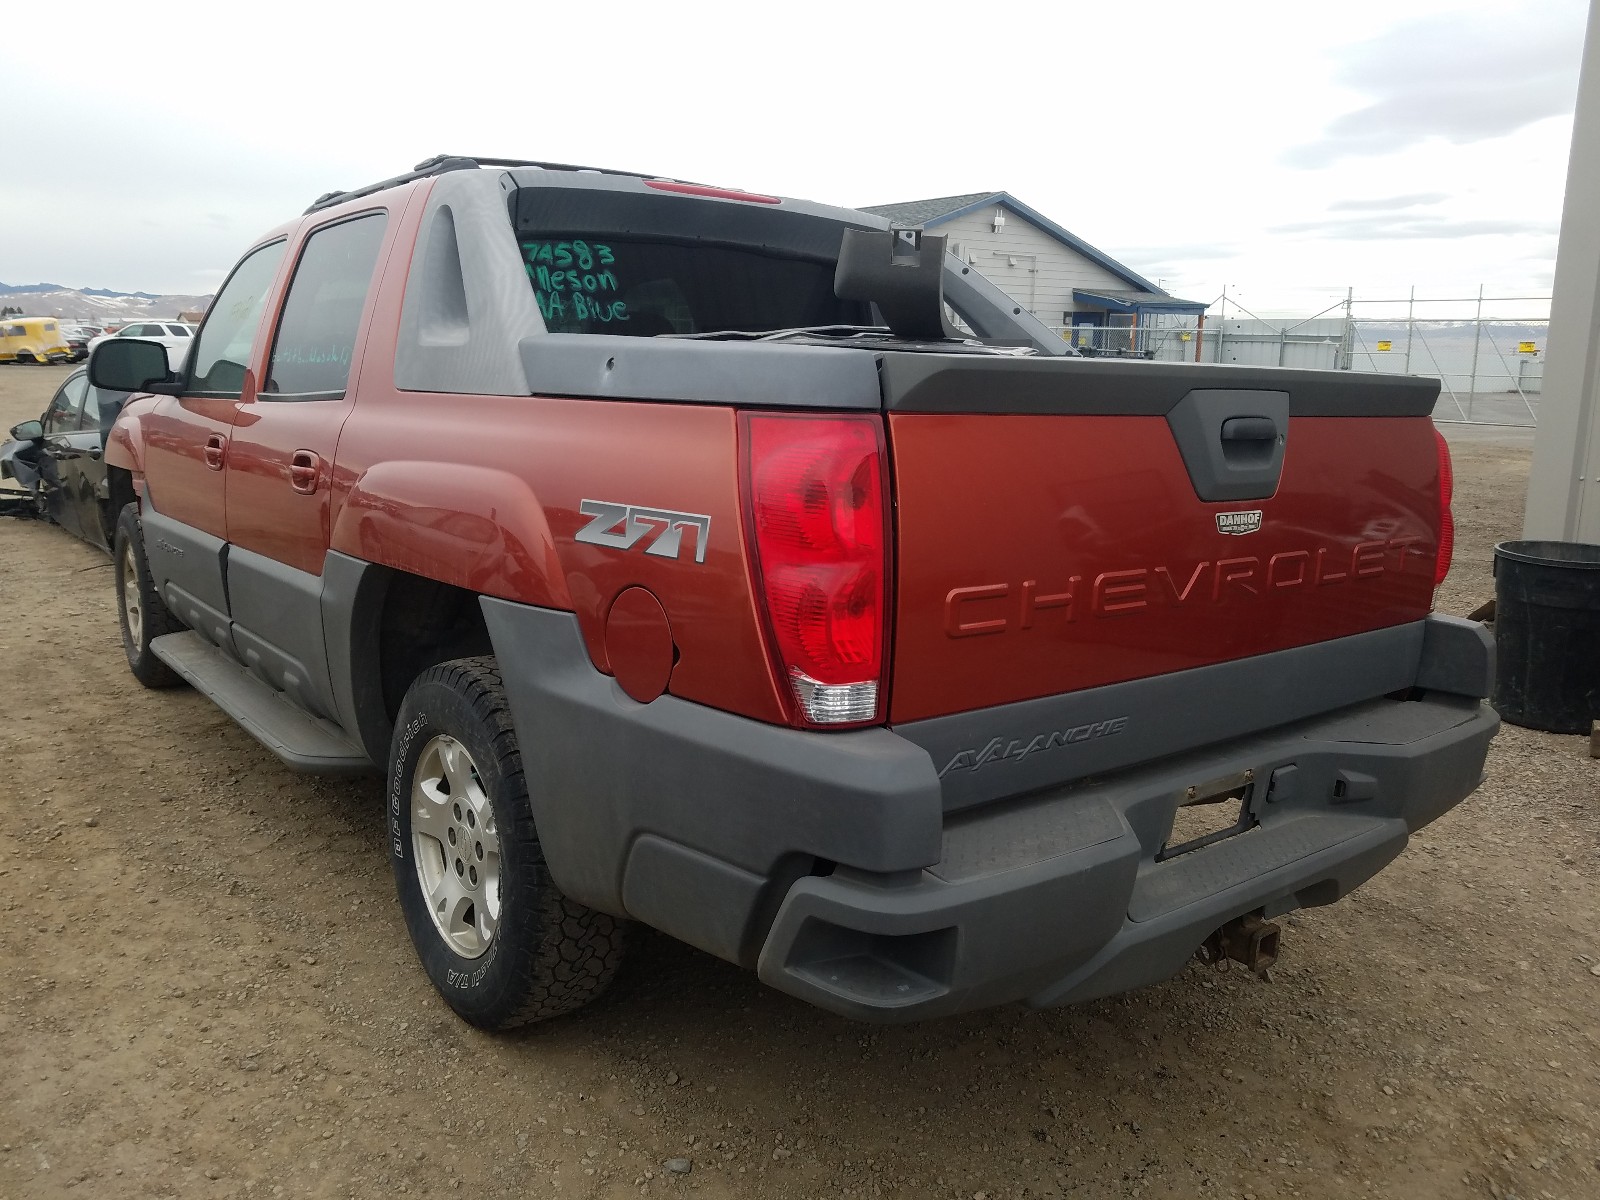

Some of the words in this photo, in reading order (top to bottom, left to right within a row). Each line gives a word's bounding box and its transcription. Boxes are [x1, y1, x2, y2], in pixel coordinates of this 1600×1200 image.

[574, 499, 712, 564] Z71
[1219, 513, 1260, 526] DANHOF
[944, 535, 1422, 639] CHEVROLET
